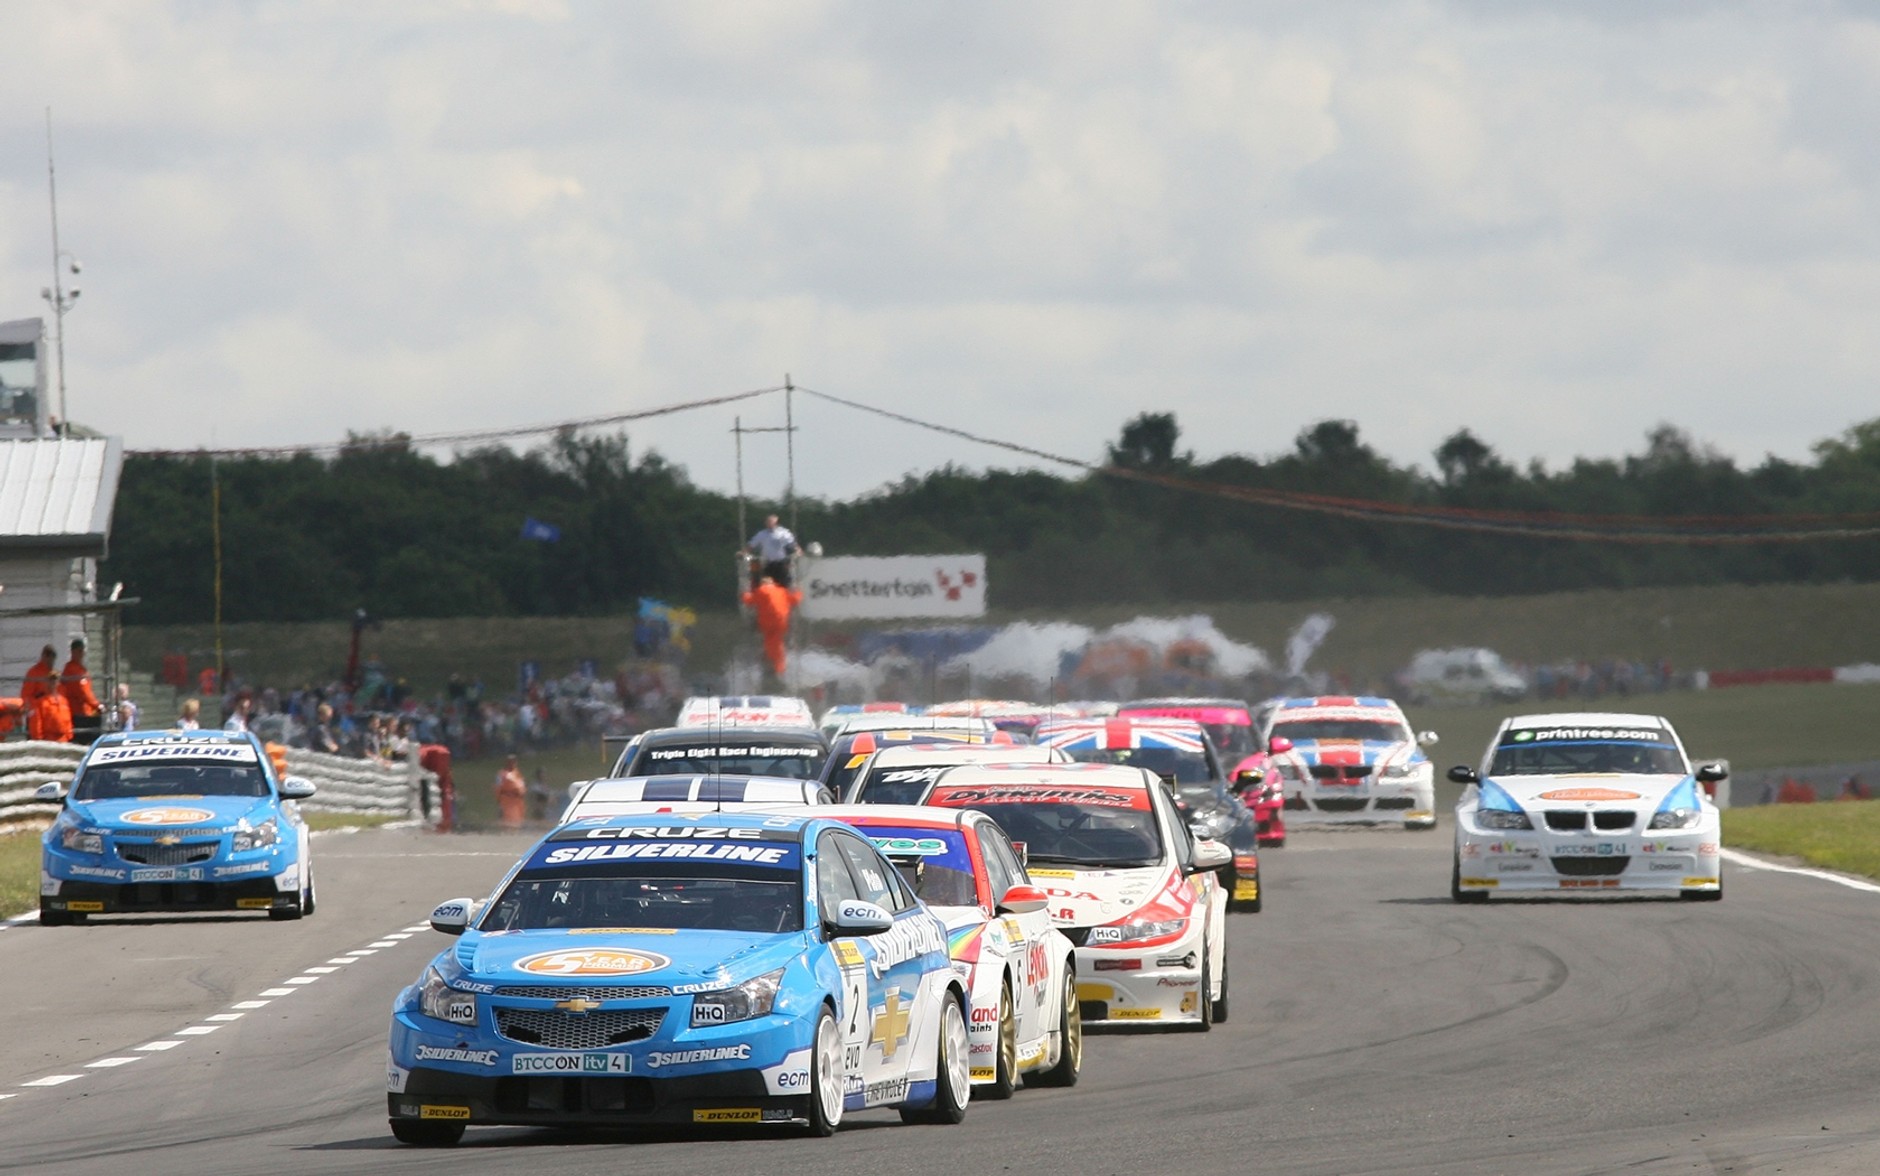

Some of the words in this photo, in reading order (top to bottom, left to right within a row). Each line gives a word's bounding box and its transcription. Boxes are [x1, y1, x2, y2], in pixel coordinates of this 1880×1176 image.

[1536, 729, 1660, 741] printree.com
[586, 827, 762, 839] CRUZE
[868, 838, 942, 850] ves
[1096, 929, 1120, 939] HiQ
[453, 979, 495, 994] CRUZE
[673, 980, 728, 994] CRUZE
[451, 1004, 474, 1018] HiQ
[695, 1006, 724, 1021] HiQ
[849, 983, 860, 1036] 2
[584, 1056, 606, 1070] itv
[611, 1056, 622, 1070] 4
[778, 1071, 809, 1088] ecm
[428, 1109, 468, 1118] DUNLOP
